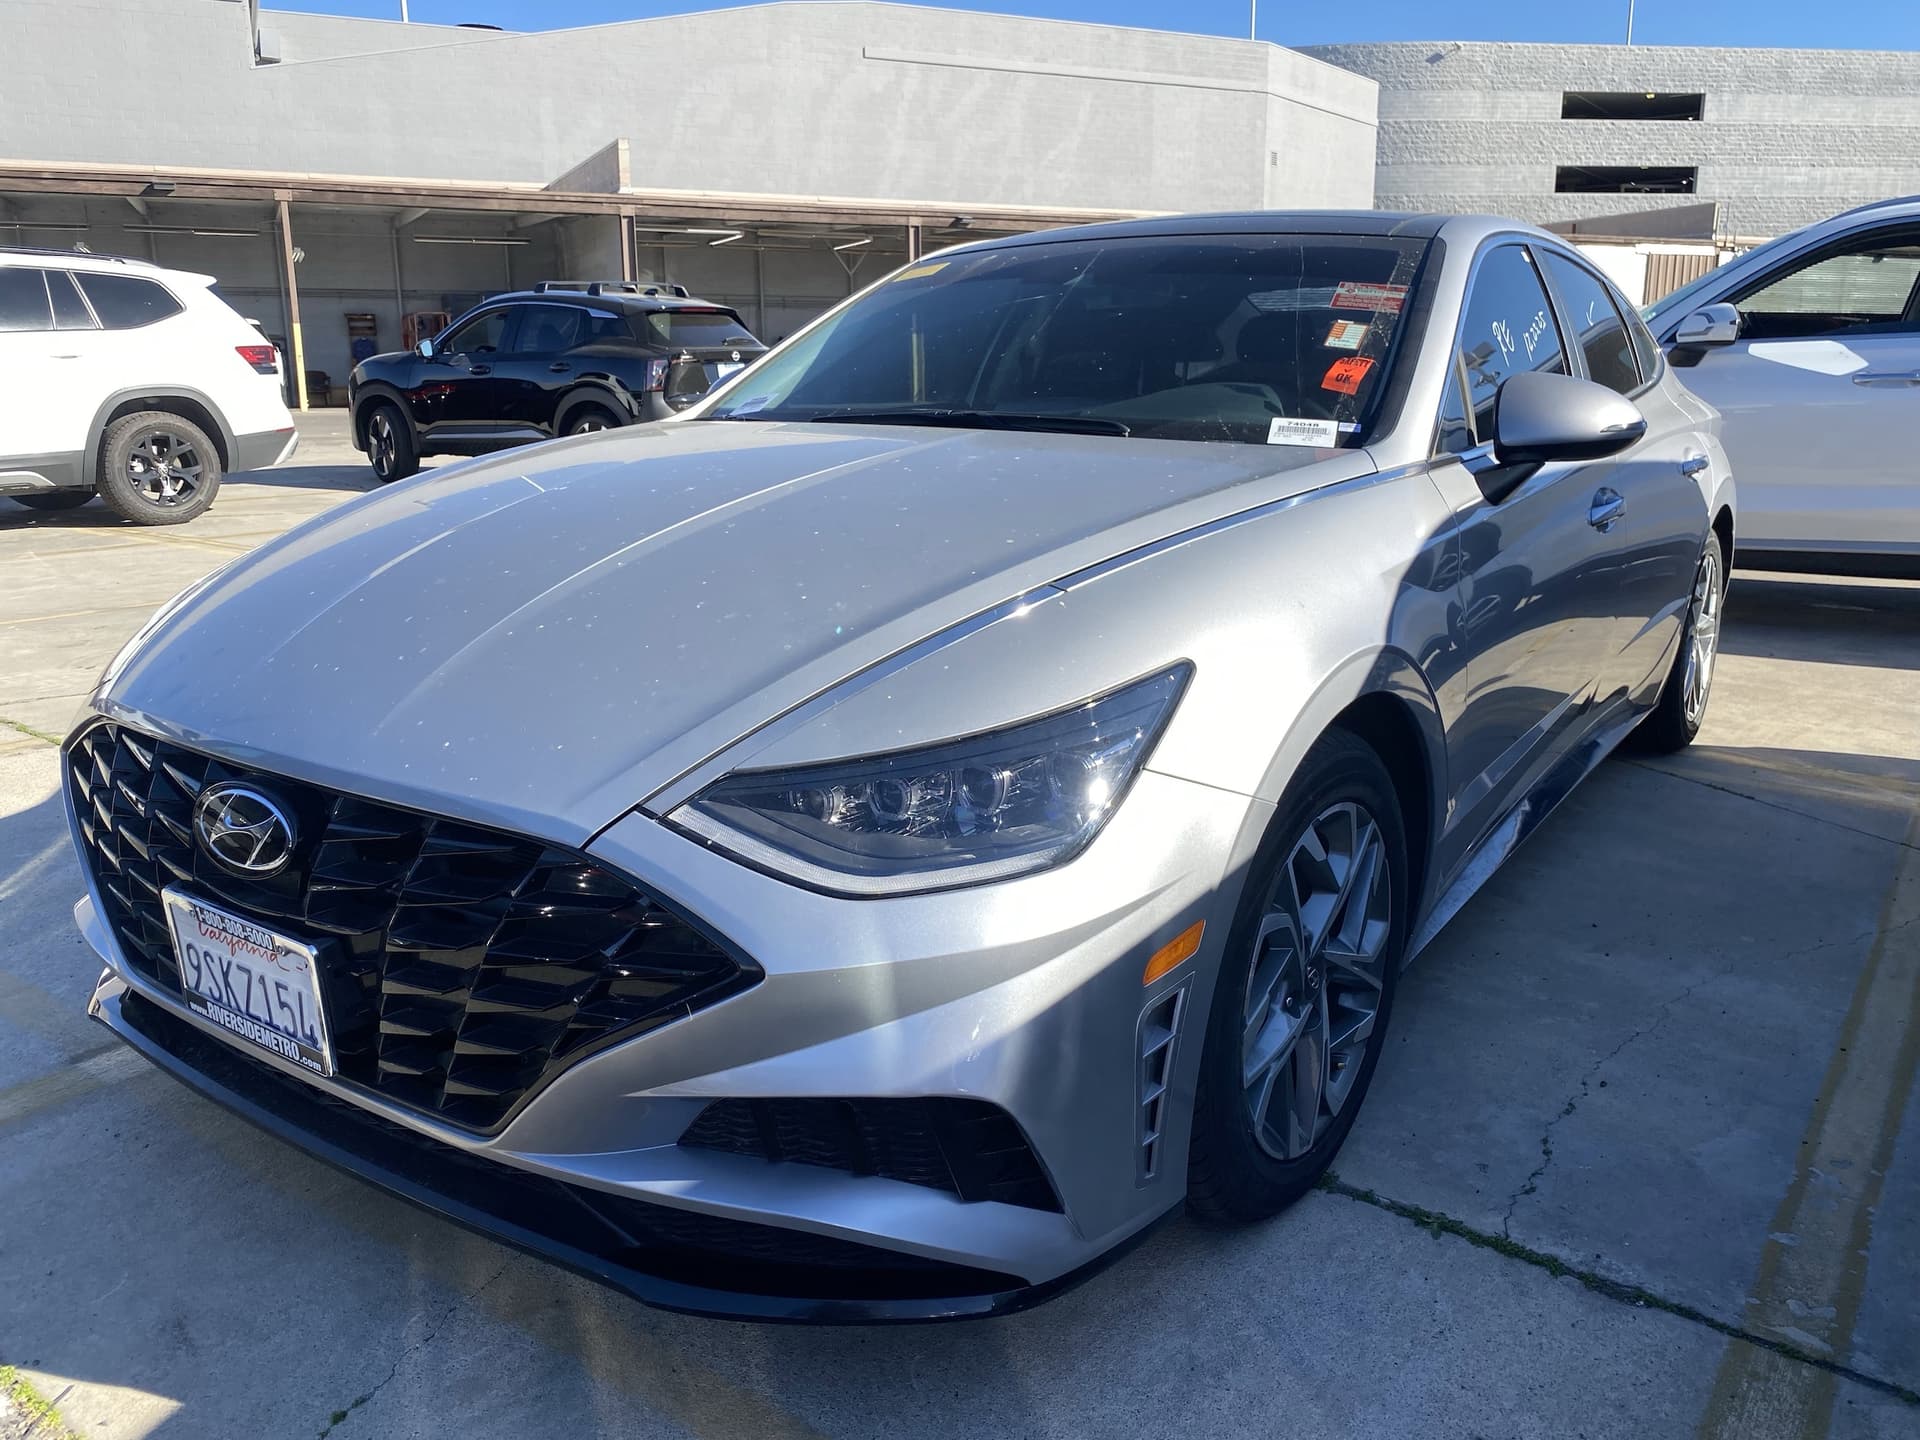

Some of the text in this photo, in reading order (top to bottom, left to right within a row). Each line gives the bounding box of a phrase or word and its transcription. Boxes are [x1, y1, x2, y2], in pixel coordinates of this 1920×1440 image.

[1336, 373, 1353, 384] OK
[196, 907, 273, 950] 1-800-808-5000
[186, 943, 319, 1049] 9SKZ154
